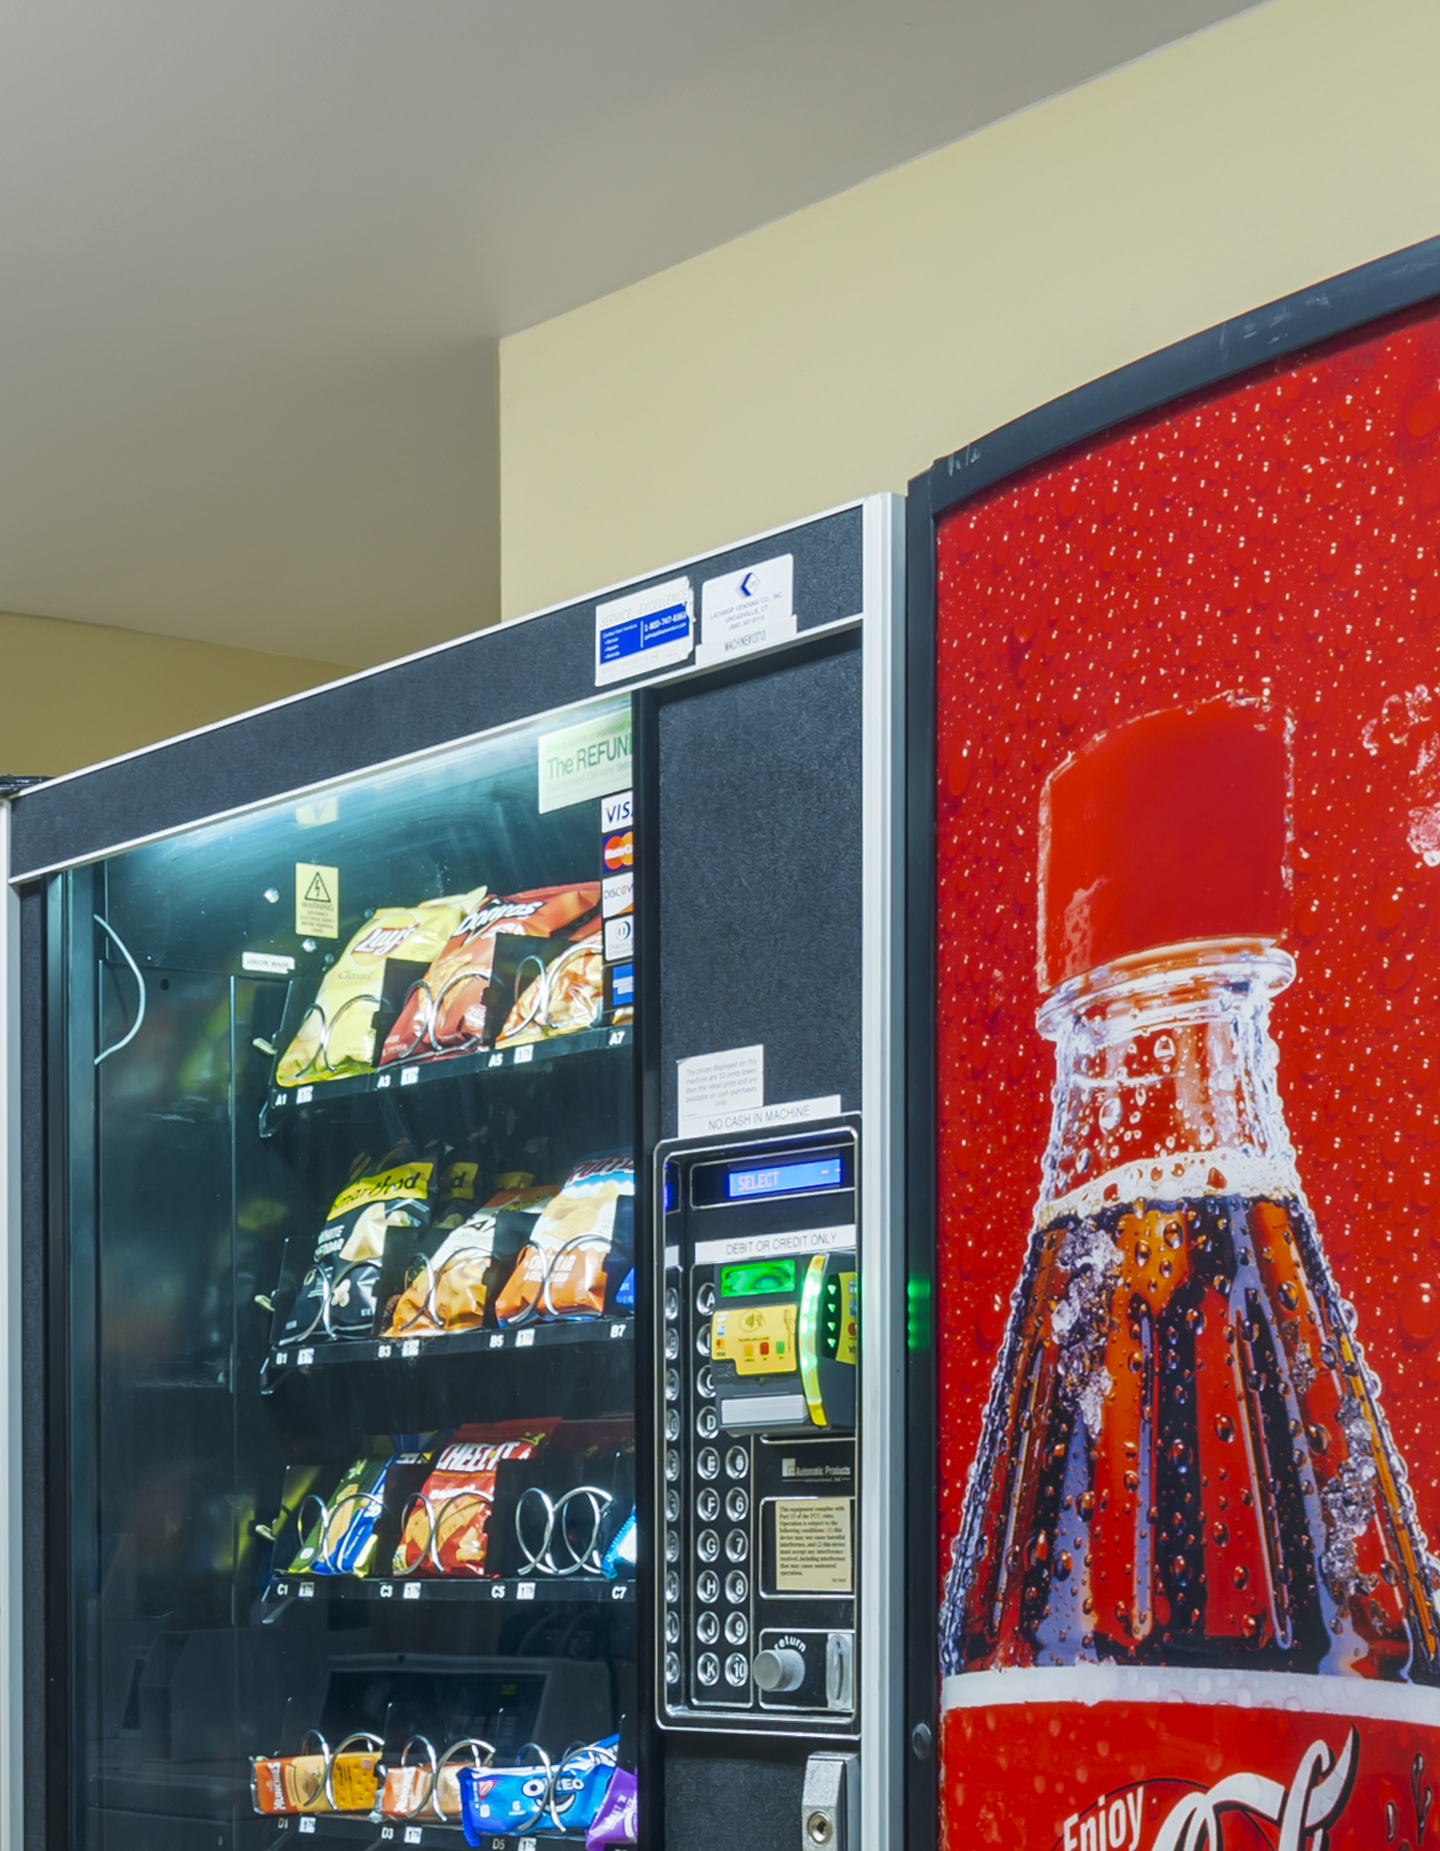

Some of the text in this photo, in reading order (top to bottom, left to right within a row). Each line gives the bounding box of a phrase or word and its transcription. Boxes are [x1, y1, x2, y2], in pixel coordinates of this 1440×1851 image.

[547, 756, 574, 780] The
[577, 732, 632, 771] REFUN
[452, 900, 544, 937] Doritos
[352, 924, 418, 955] Lay's
[609, 1032, 625, 1045] A7
[488, 1053, 502, 1067] A5
[378, 1075, 391, 1088] A3
[274, 1093, 288, 1106] A1
[708, 1105, 809, 1131] NO CASH IN MACHINE
[738, 1171, 780, 1191] SELECT
[726, 1233, 837, 1255] DEBIT OR CREDIT ONLY
[611, 1325, 625, 1338] B7
[490, 1334, 503, 1347] B5
[378, 1345, 391, 1358] B3
[276, 1353, 288, 1364] B1
[706, 1538, 716, 1553] G
[277, 1584, 288, 1595] C1
[380, 1585, 393, 1597] C3
[492, 1587, 505, 1598] C5
[612, 1587, 627, 1599] C7
[706, 1579, 744, 1595] H 8
[706, 1620, 744, 1636] J 9
[773, 1636, 806, 1653] return
[706, 1661, 745, 1678] K 10
[278, 1819, 288, 1828] D1
[381, 1828, 393, 1839] D3
[492, 1838, 505, 1849] D5
